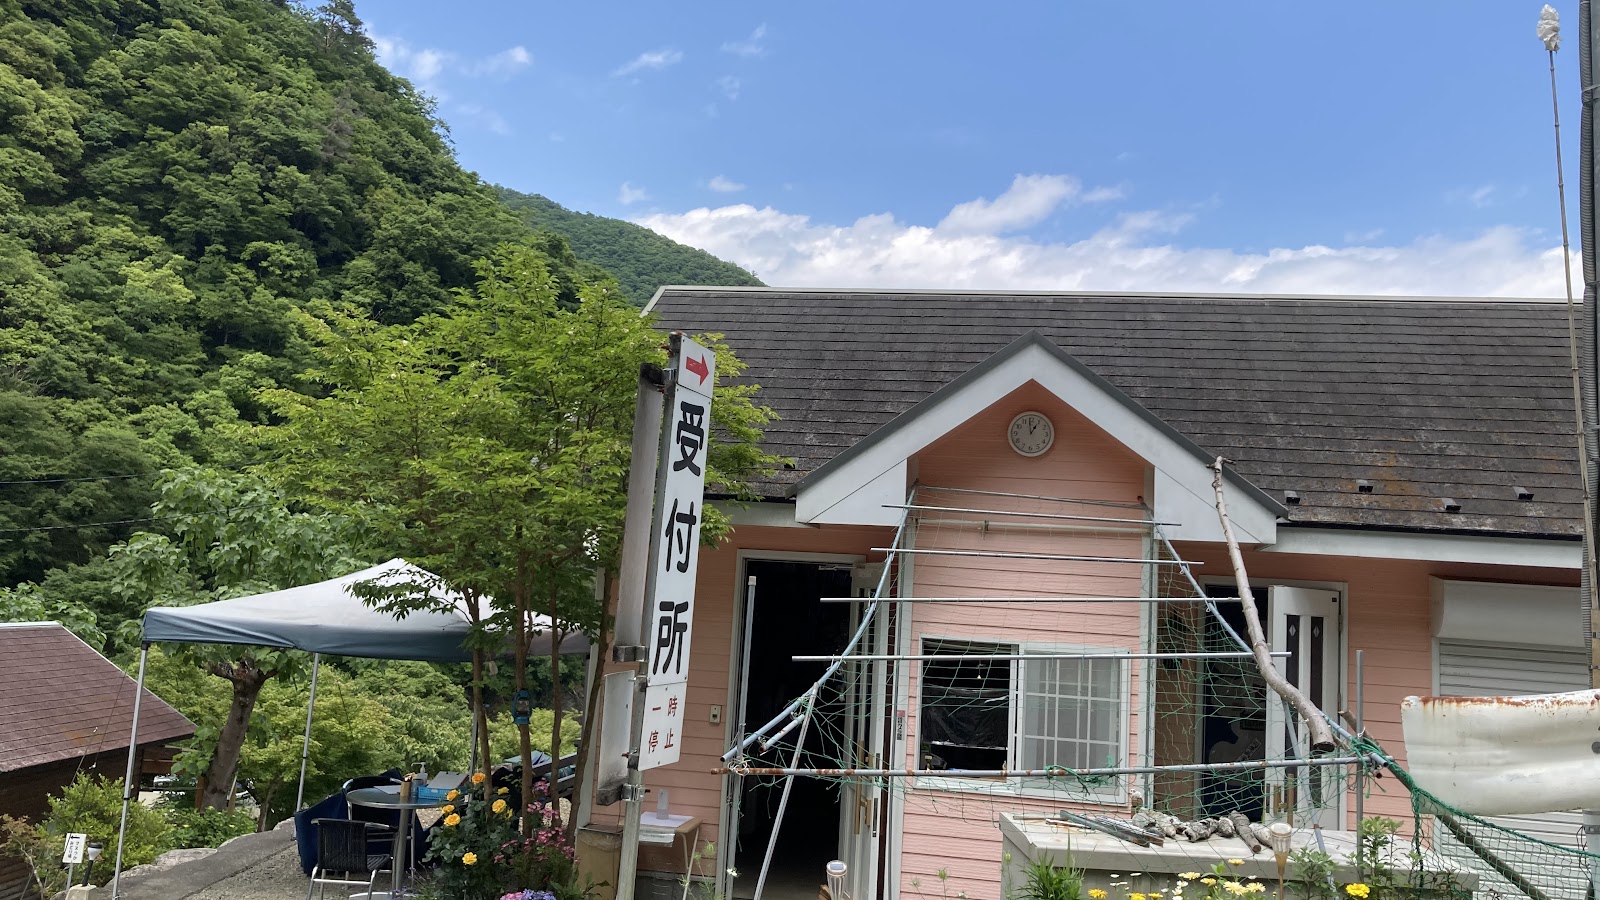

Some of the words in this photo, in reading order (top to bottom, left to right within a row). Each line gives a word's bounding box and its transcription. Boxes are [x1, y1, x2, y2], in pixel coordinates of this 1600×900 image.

[653, 401, 705, 675] 受付所
[652, 694, 678, 717] 一時
[648, 728, 674, 754] 停止
